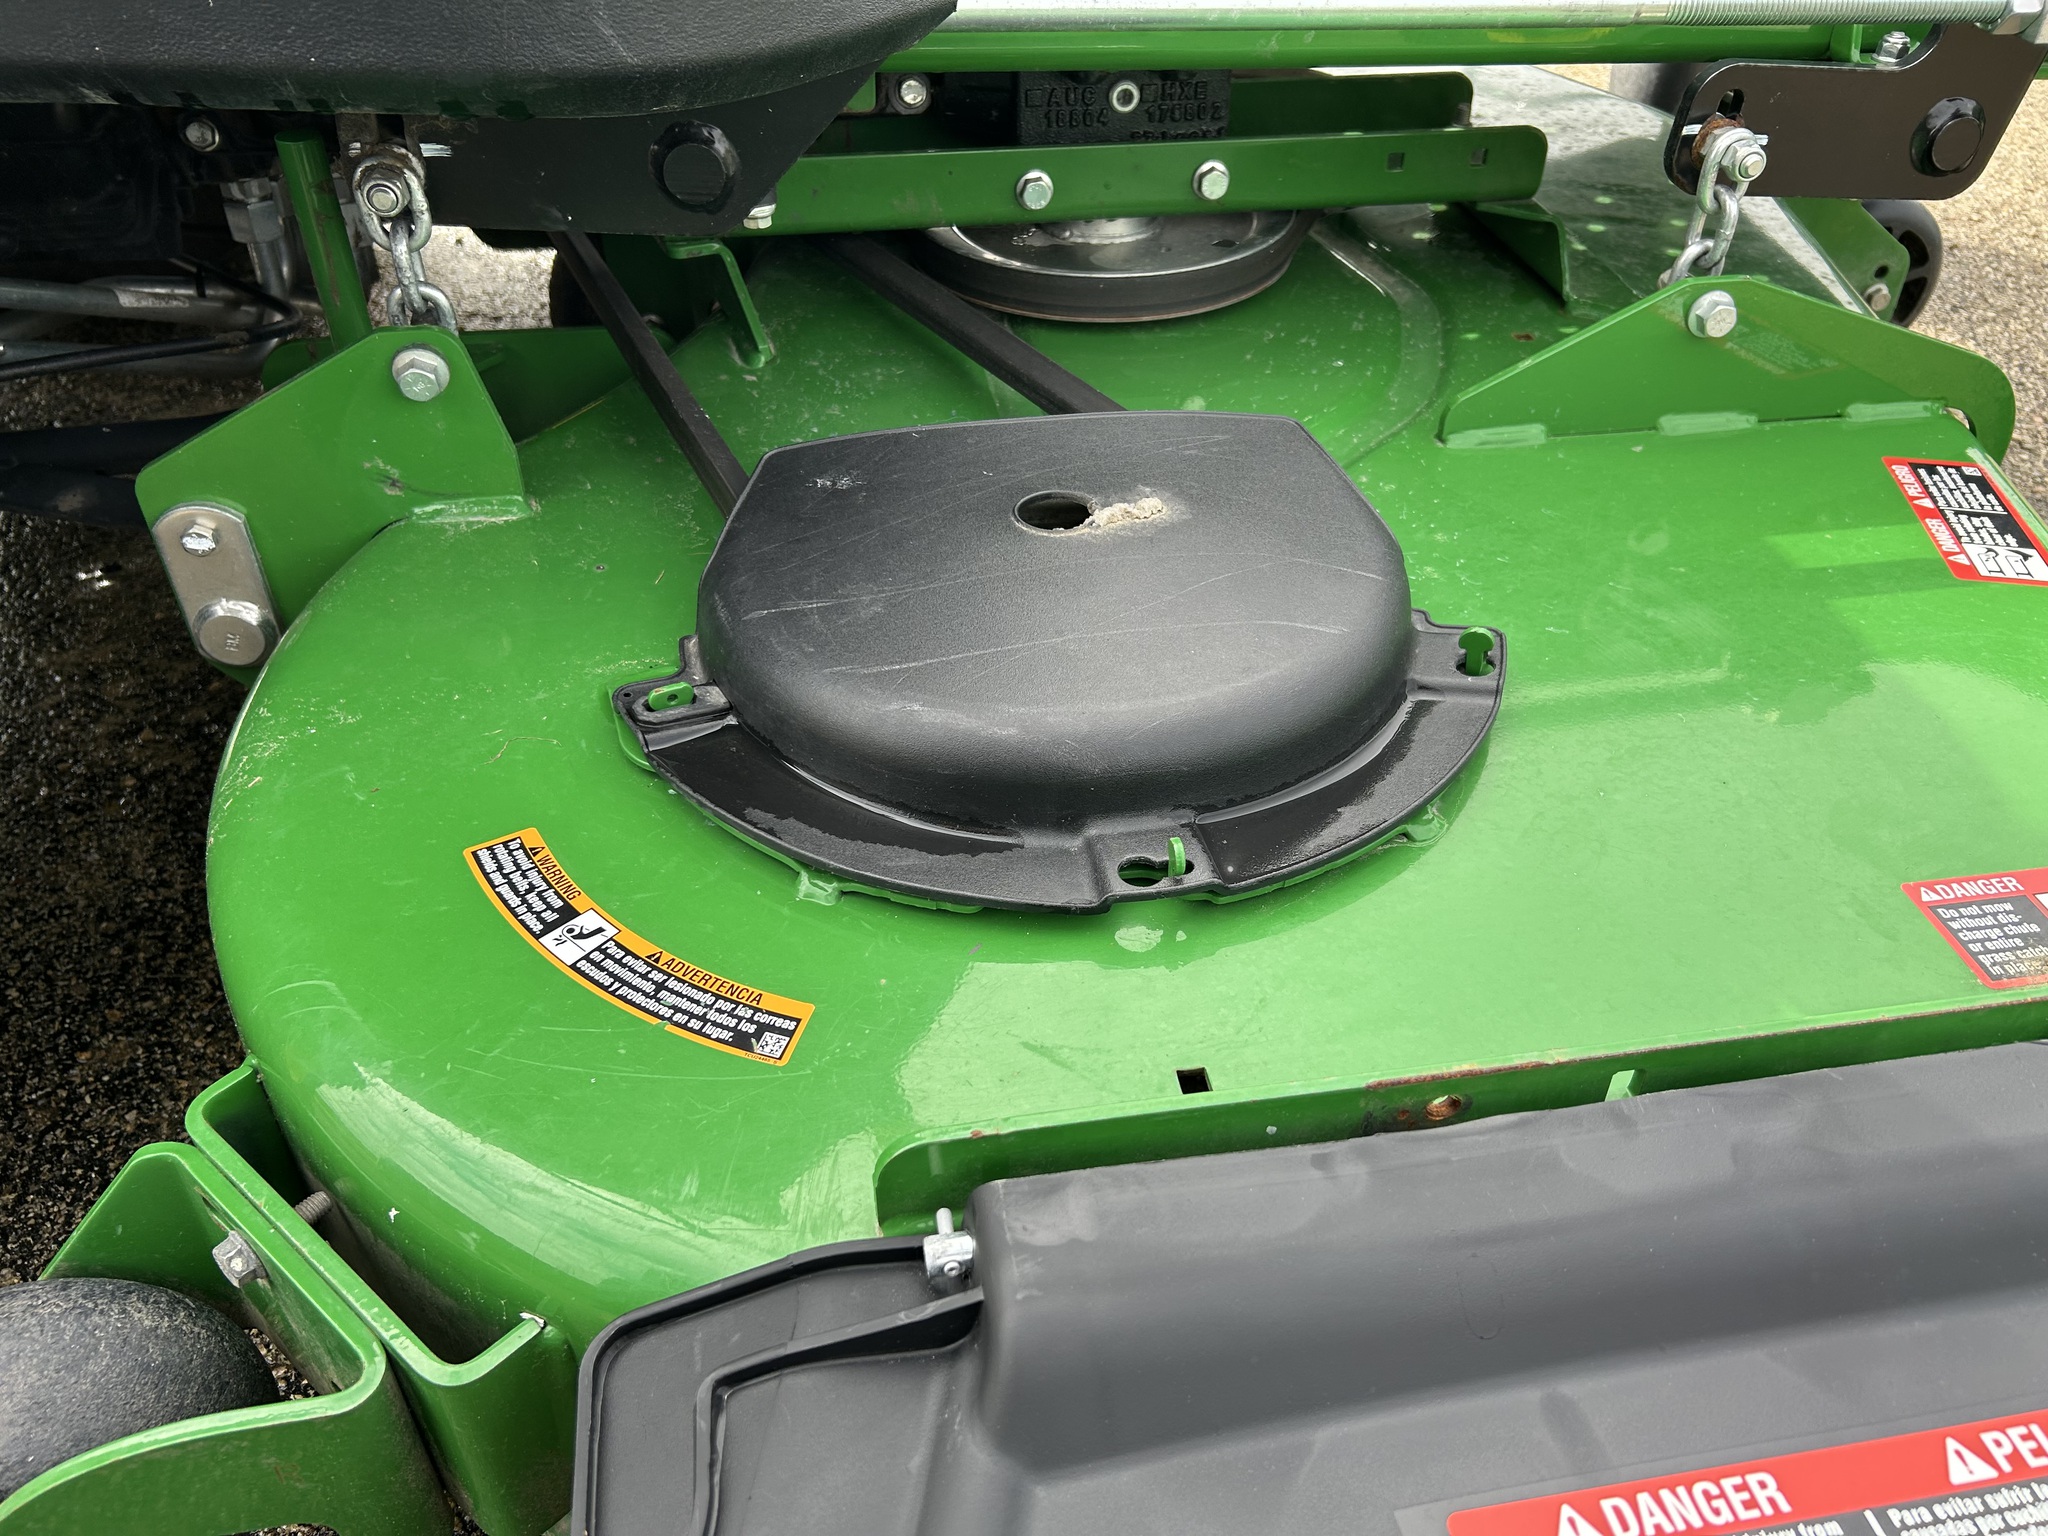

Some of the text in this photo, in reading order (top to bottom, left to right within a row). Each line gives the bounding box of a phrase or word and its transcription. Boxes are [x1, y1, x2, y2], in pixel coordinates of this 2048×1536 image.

[1047, 86, 1097, 107] AUC
[1891, 464, 1926, 497] PELIGRO
[1925, 518, 1961, 553] DANGER
[488, 871, 508, 886] and
[493, 843, 560, 923] rotating belts, keep all
[508, 838, 564, 909] To avoid injury from
[537, 854, 581, 900] WARNING
[495, 884, 522, 908] guards
[1934, 877, 2025, 900] DANGER
[514, 904, 528, 916] in
[1937, 902, 2014, 919] Do not mow
[1947, 912, 2022, 930] without dis-
[518, 912, 544, 934] place.
[1957, 922, 2041, 941] charge chute
[1967, 937, 2025, 952] or entire
[1977, 951, 2016, 967] grass
[1987, 964, 2005, 976] in
[589, 950, 758, 1034] en movimiento, mantener todos los
[601, 940, 798, 1031] Para evitar ser lesionado por las correas
[661, 957, 764, 1006] ADVERTENCIA
[575, 959, 734, 1043] escudos y protectores en su lugar.
[1599, 1471, 1792, 1536] DANGER
[1886, 1506, 1933, 1528] Para
[1932, 1496, 1985, 1520] evitar
[1974, 1513, 2005, 1536] por
